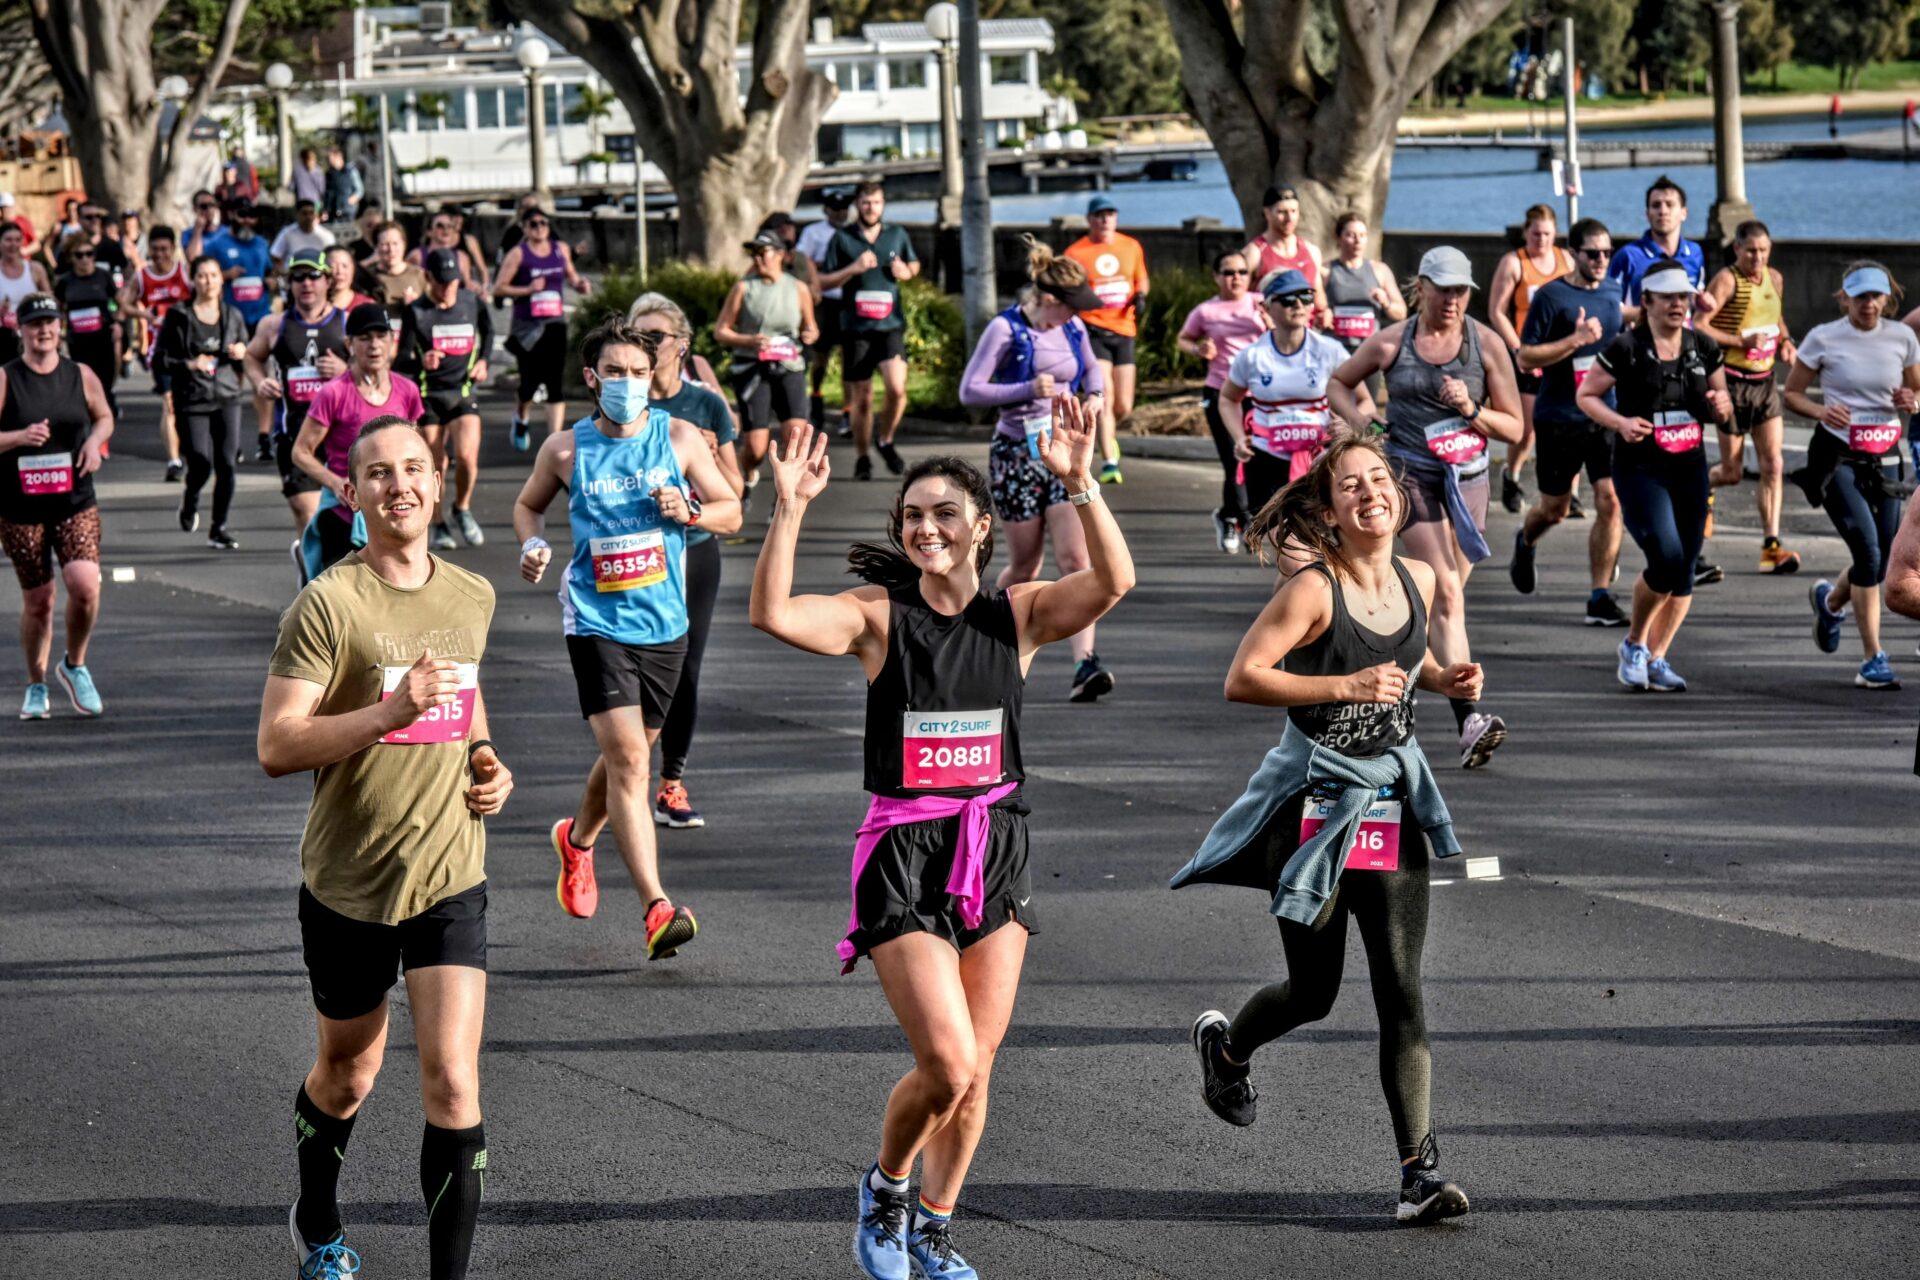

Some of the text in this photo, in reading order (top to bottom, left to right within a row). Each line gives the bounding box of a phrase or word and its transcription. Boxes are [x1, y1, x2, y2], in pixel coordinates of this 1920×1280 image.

[1274, 428, 1318, 442] 20989
[1855, 429, 1897, 442] 20047
[582, 469, 643, 497] unicef
[607, 516, 642, 529] every
[601, 552, 659, 576] 96354
[1328, 722, 1351, 732] FOR
[918, 745, 992, 768] 20881
[1352, 830, 1384, 850] 16
